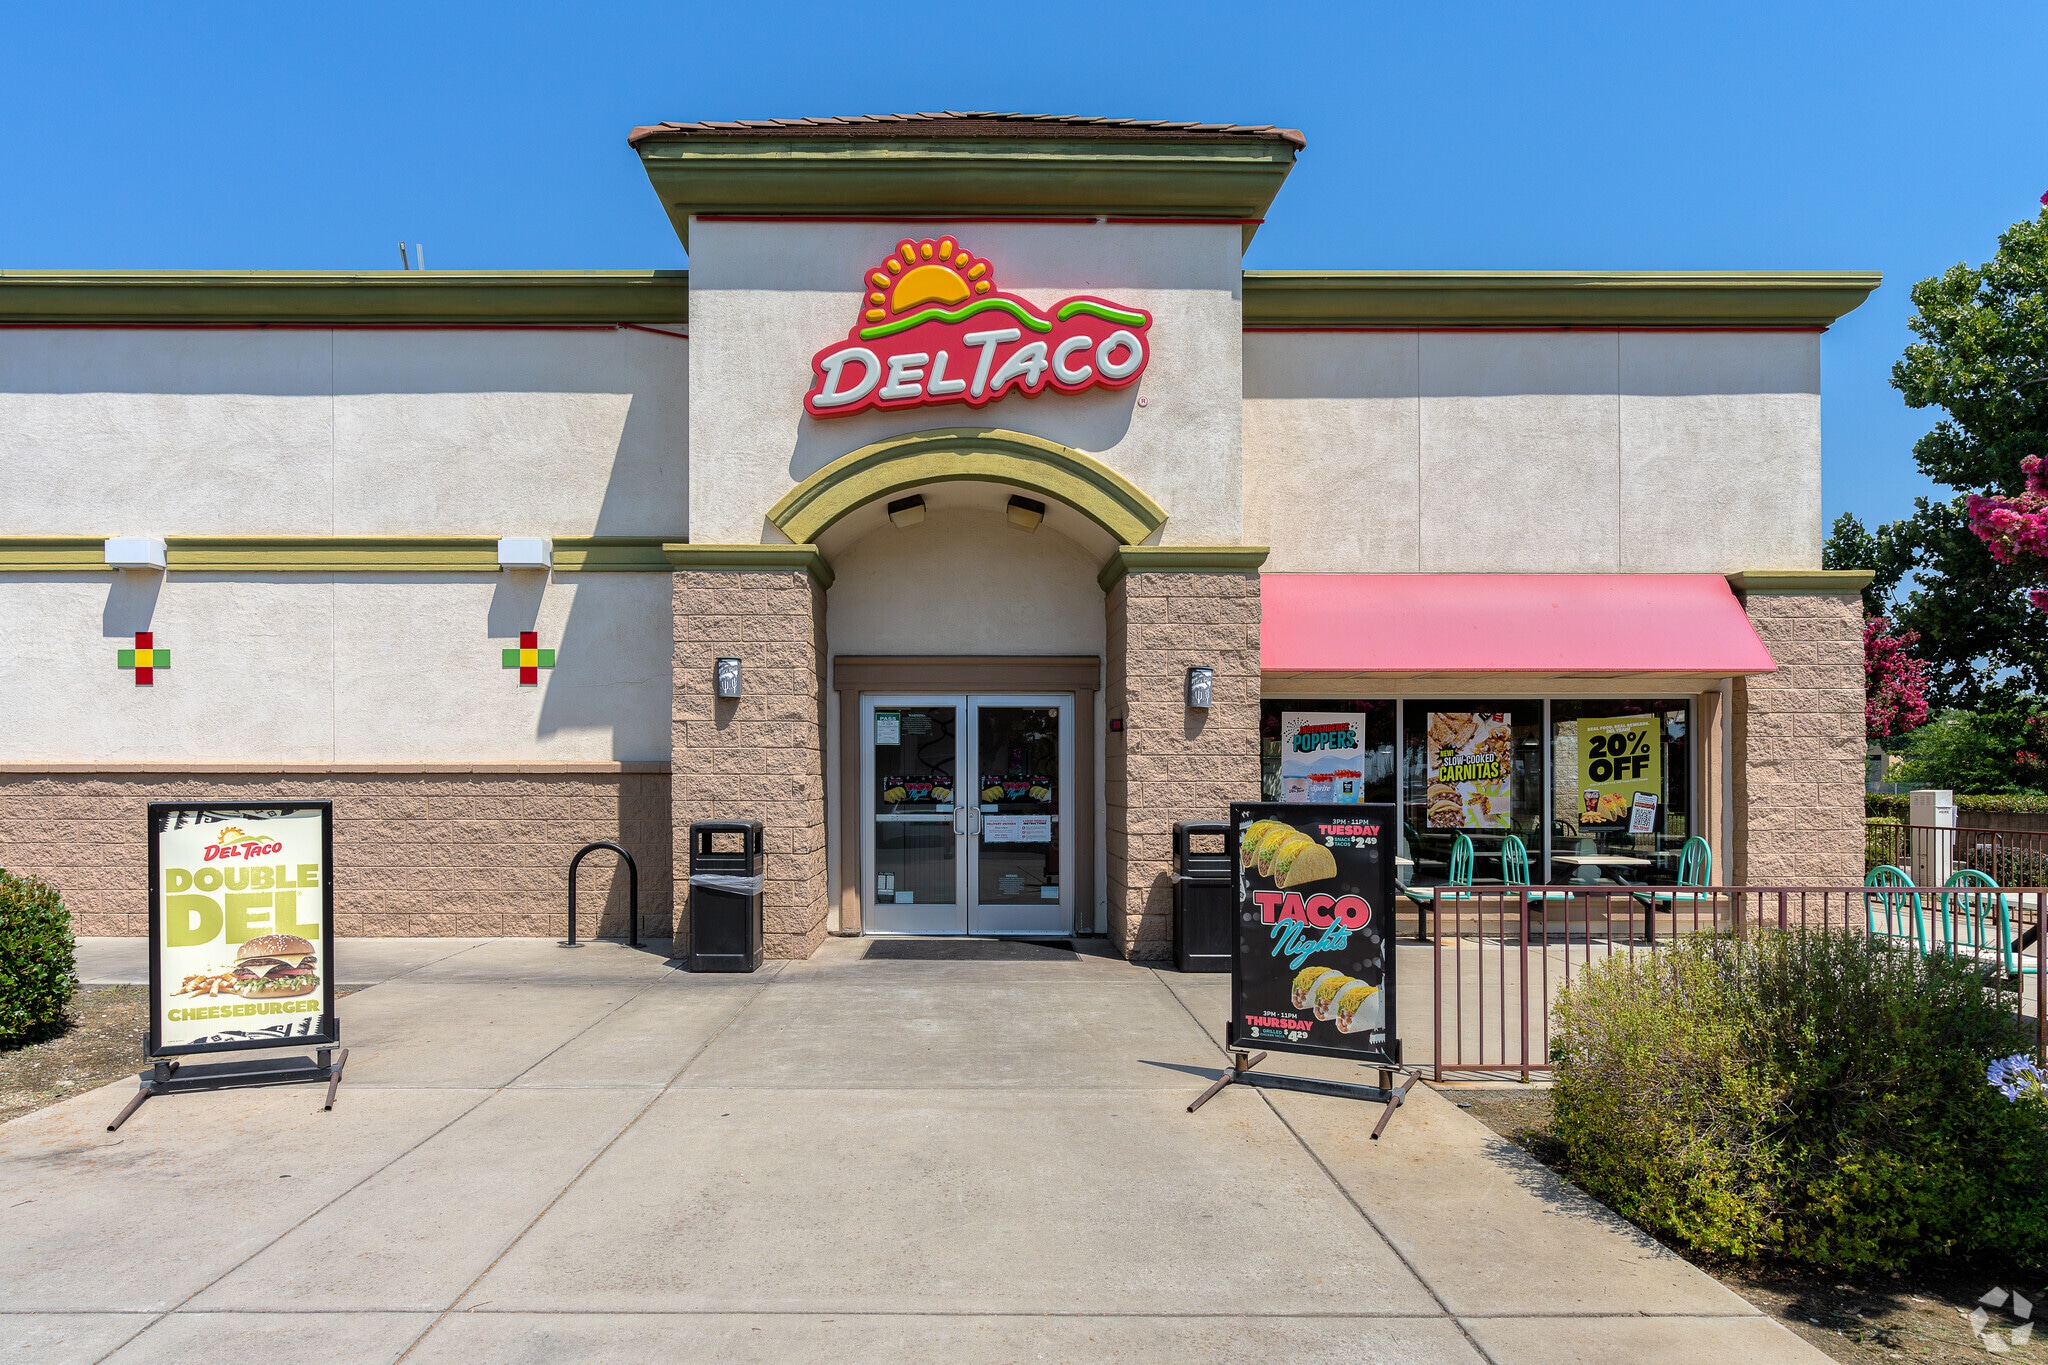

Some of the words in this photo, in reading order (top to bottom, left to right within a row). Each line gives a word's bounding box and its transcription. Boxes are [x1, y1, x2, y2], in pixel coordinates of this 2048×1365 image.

[812, 347, 966, 407] DEL
[963, 328, 1143, 398] TACO
[1300, 723, 1349, 734] INDEPENDENCE
[1293, 730, 1357, 752] POPPERS
[1588, 730, 1651, 759] 20%
[1440, 749, 1454, 757] NEW!
[1443, 753, 1495, 767] SLOW-COOKED
[1439, 761, 1500, 783] CARNITAS
[1588, 754, 1650, 783] OFF
[905, 782, 933, 791] TACO
[1002, 781, 1030, 791] TACO
[1318, 824, 1381, 836] TUESDAY
[203, 844, 241, 862] DEL
[240, 841, 283, 860] TACO
[1324, 835, 1334, 848] 3
[165, 863, 319, 893] DOUBLE
[166, 890, 320, 948] DEL
[1253, 890, 1372, 930] TACO
[1270, 916, 1352, 970] Nights
[167, 999, 320, 1022] CHEESEBURGER
[1245, 1015, 1313, 1031] THURSDAY
[1250, 1026, 1260, 1038] 3
